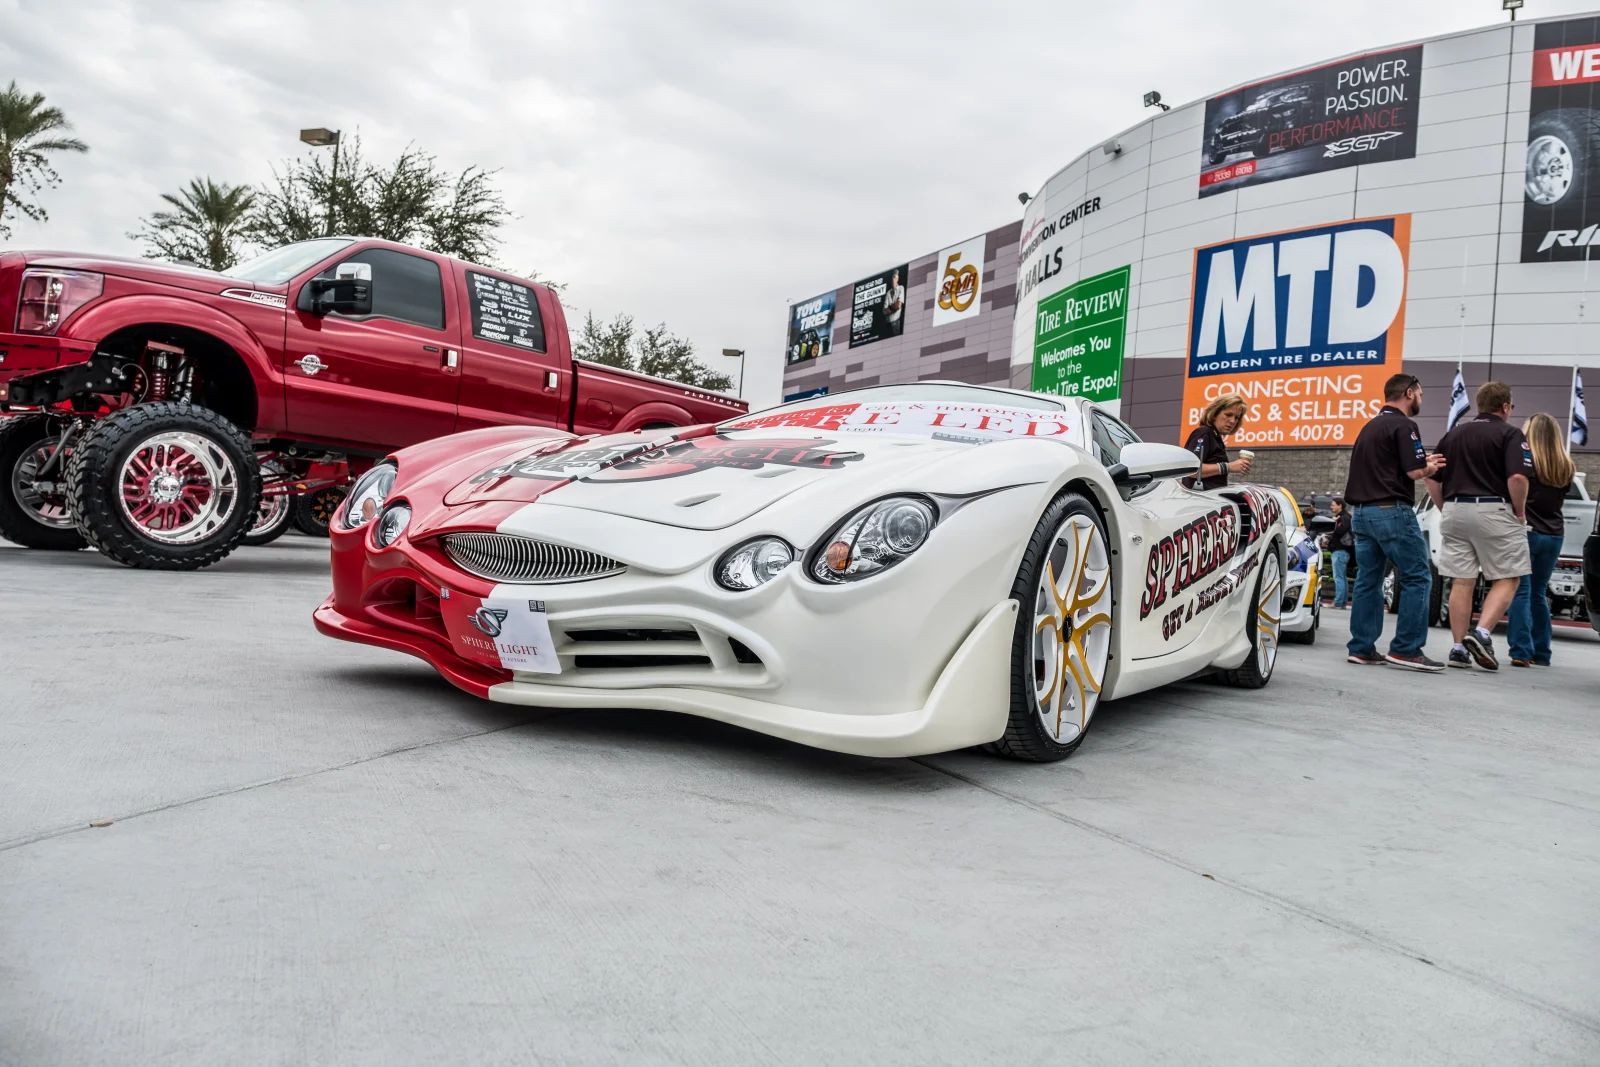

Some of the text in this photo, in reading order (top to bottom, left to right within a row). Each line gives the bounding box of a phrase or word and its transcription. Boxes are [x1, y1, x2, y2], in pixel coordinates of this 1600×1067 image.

[1337, 59, 1410, 90] POWER.
[1325, 84, 1408, 116] PASSION.
[1268, 107, 1407, 149] PERFORMANCE.
[1323, 131, 1400, 158] SCT
[1059, 196, 1102, 230] CENTER
[1197, 228, 1405, 357] MTD
[796, 299, 823, 319] TOYO
[800, 310, 831, 331] TIRES
[1041, 336, 1112, 368] Welcomes You
[1197, 350, 1378, 372] MODERN TIRE DEALER
[1057, 360, 1082, 379] to the
[1060, 381, 1079, 396] Tire
[1082, 370, 1118, 395] Expo!
[1204, 374, 1363, 401] CONNECTING
[684, 390, 740, 407] PLATINUM
[1266, 402, 1283, 421] &
[1288, 399, 1381, 420] SELLERS
[929, 413, 1069, 437] LED
[1234, 426, 1284, 443] Booth
[1289, 424, 1345, 441] 40078
[1140, 505, 1239, 621] SPHERE
[500, 643, 538, 655] LIGHT
